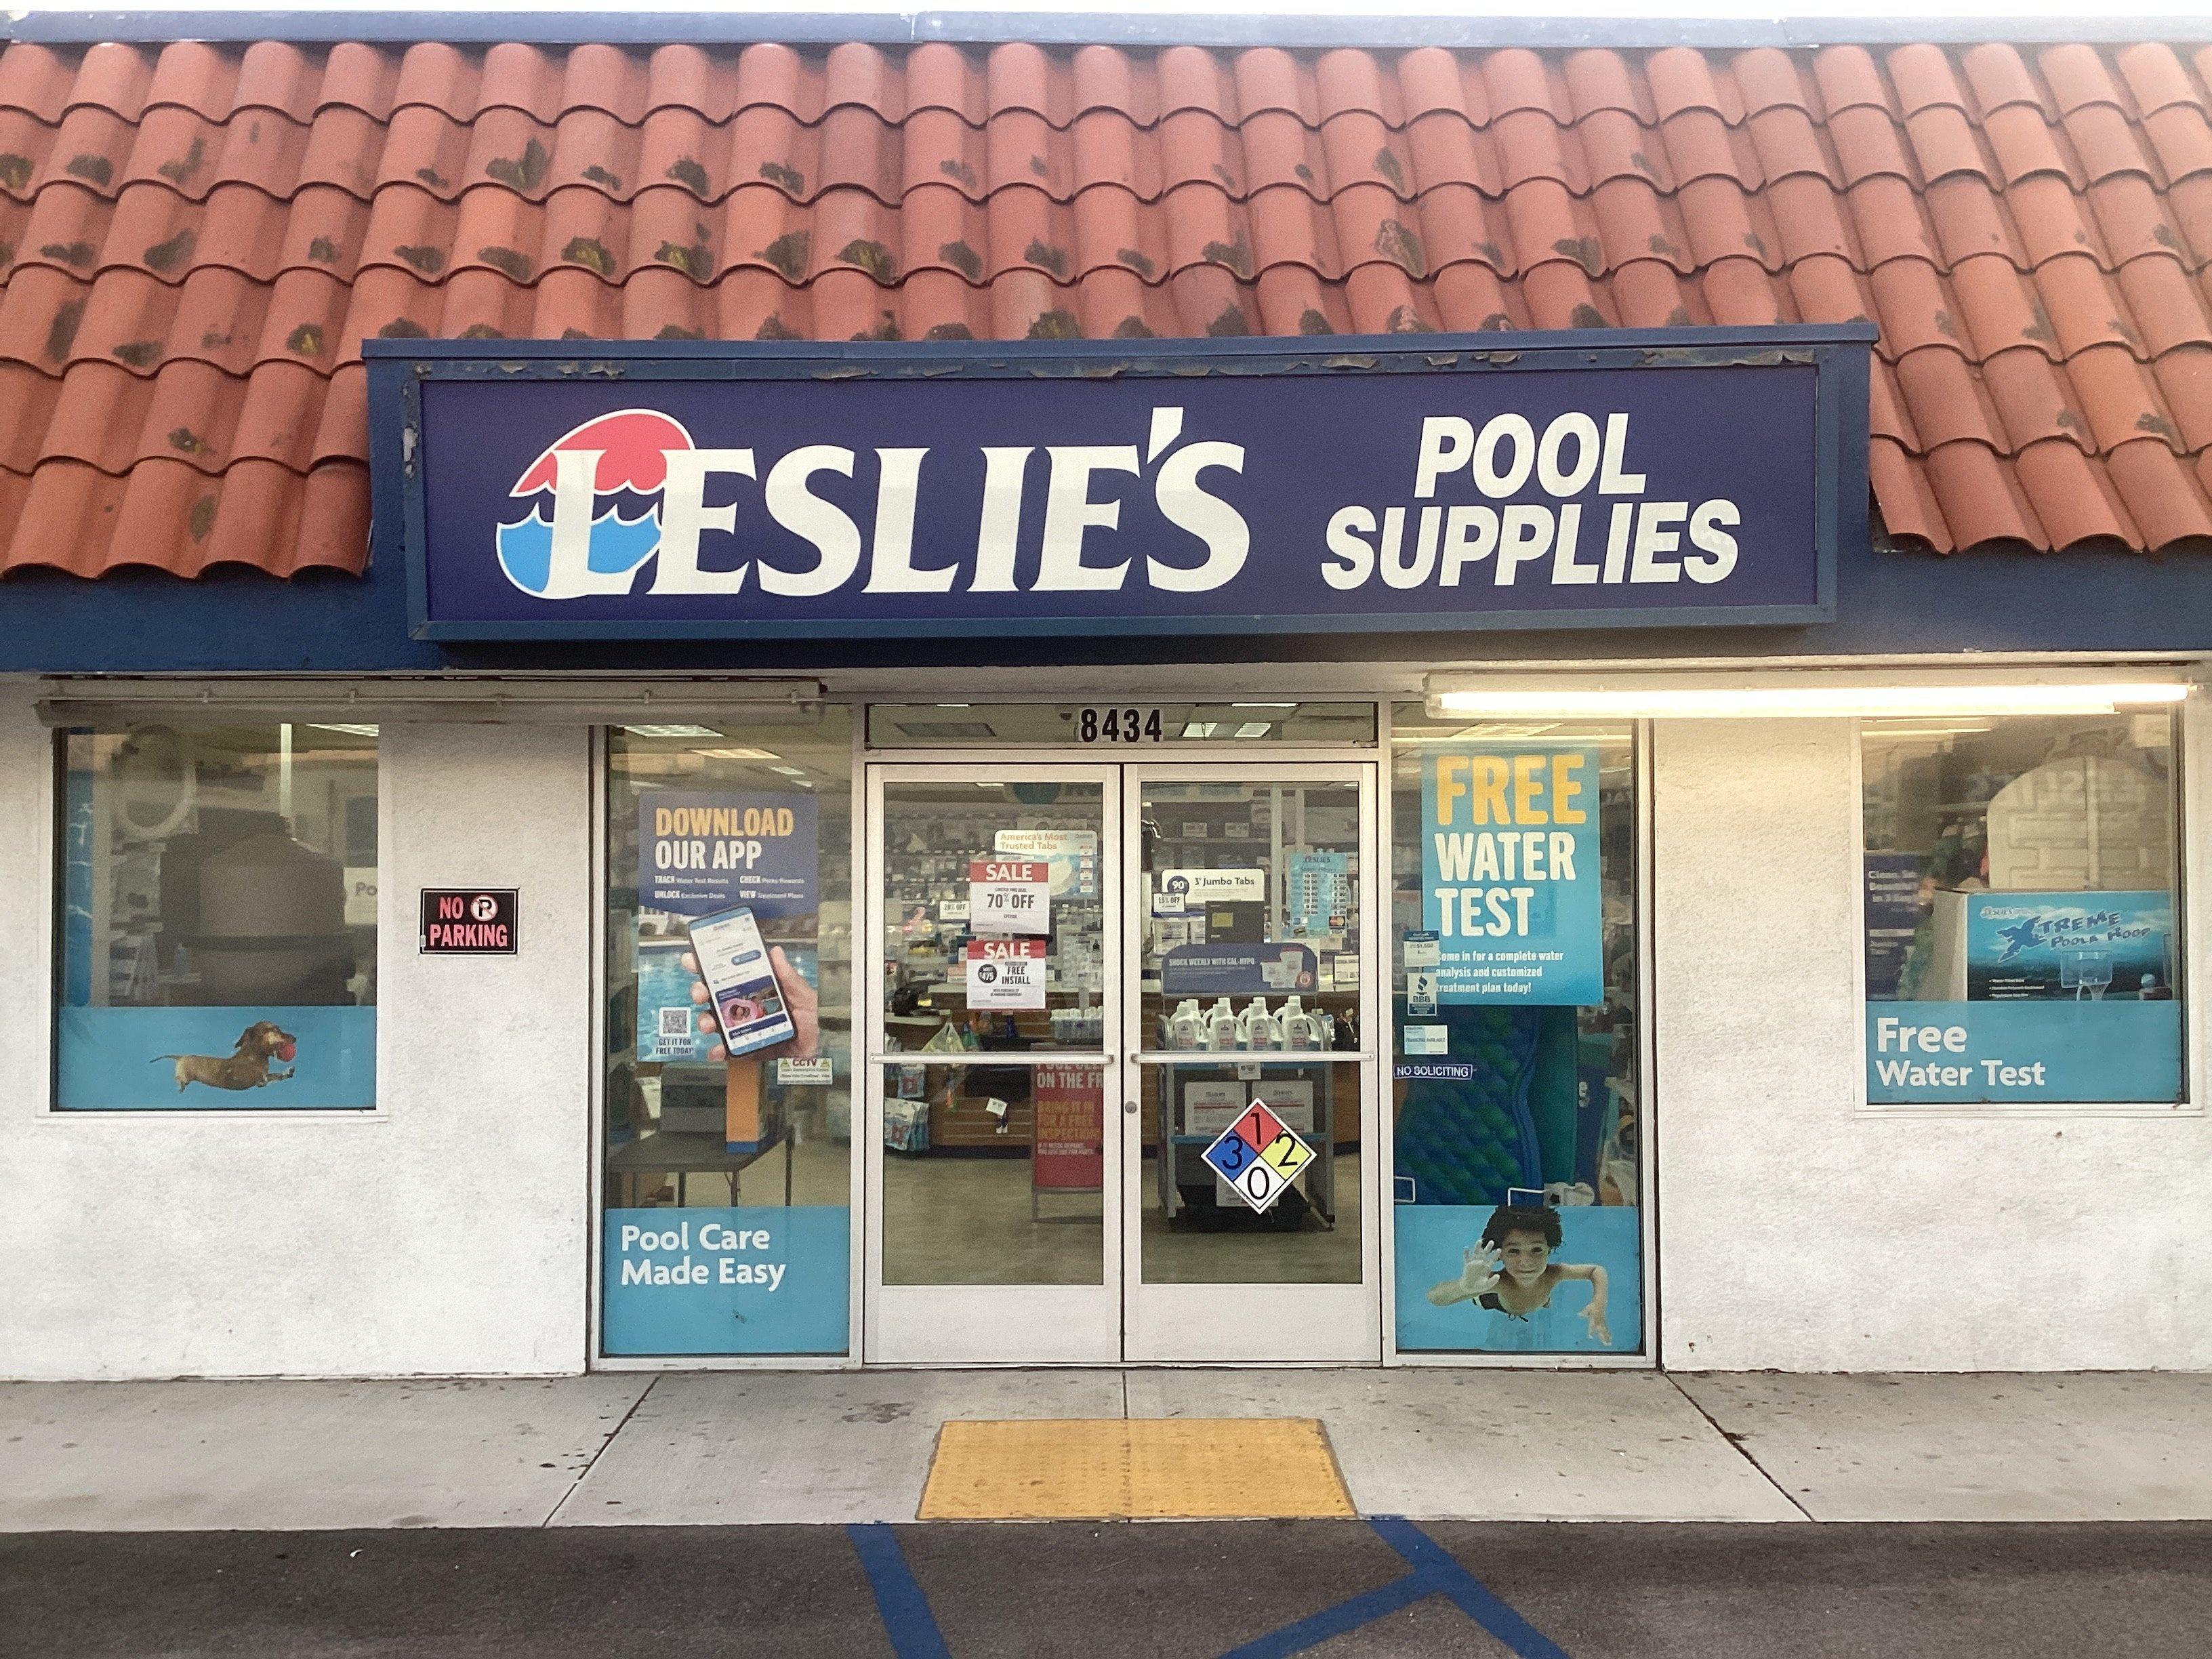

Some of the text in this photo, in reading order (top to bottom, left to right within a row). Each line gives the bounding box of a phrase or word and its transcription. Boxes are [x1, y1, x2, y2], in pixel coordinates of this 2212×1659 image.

[1414, 411, 1646, 498] POOL
[542, 407, 1250, 596] LESLIE'S
[1321, 499, 1740, 590] SUPPLIES
[1080, 708, 1162, 742] 8434
[1436, 754, 1586, 825] FREE
[655, 807, 794, 837] DOWNLOAD
[1000, 833, 1042, 841] America's
[1045, 833, 1067, 841] Most
[1000, 842, 1057, 850] Trusted Tabs
[655, 840, 762, 869] OUR APP
[1434, 832, 1576, 881] WATER
[985, 863, 1033, 881] SALE
[1203, 876, 1232, 886] Jumbo
[1235, 877, 1254, 886] Tabs
[440, 896, 464, 920] NO
[987, 893, 1035, 909] 70% OFF
[1435, 886, 1534, 937] TEST
[429, 924, 508, 947] PARKING
[1996, 910, 2121, 964] XTREME
[2050, 926, 2150, 948] POOLA HOOP
[983, 942, 1031, 960] SALE
[1438, 950, 1564, 962] ome in for a complete water
[1002, 976, 1031, 985] INSTALL
[1007, 966, 1025, 975] FREE
[1435, 966, 1542, 978] analysis and customized
[1482, 983, 1501, 994] plan
[1503, 982, 1532, 994] today!
[1876, 1017, 1968, 1053] Free
[792, 1058, 817, 1067] CCTV
[1397, 1065, 1469, 1078] NO SOLICITING
[1875, 1059, 2046, 1086] Water Test
[1037, 1071, 1055, 1088] ON
[1059, 1071, 1084, 1088] THE
[1250, 1112, 1261, 1145] 1
[1222, 1133, 1298, 1170] 3 2
[1247, 1166, 1271, 1200] 0
[621, 1221, 771, 1252] Pool Care
[621, 1255, 786, 1292] Made Easy
